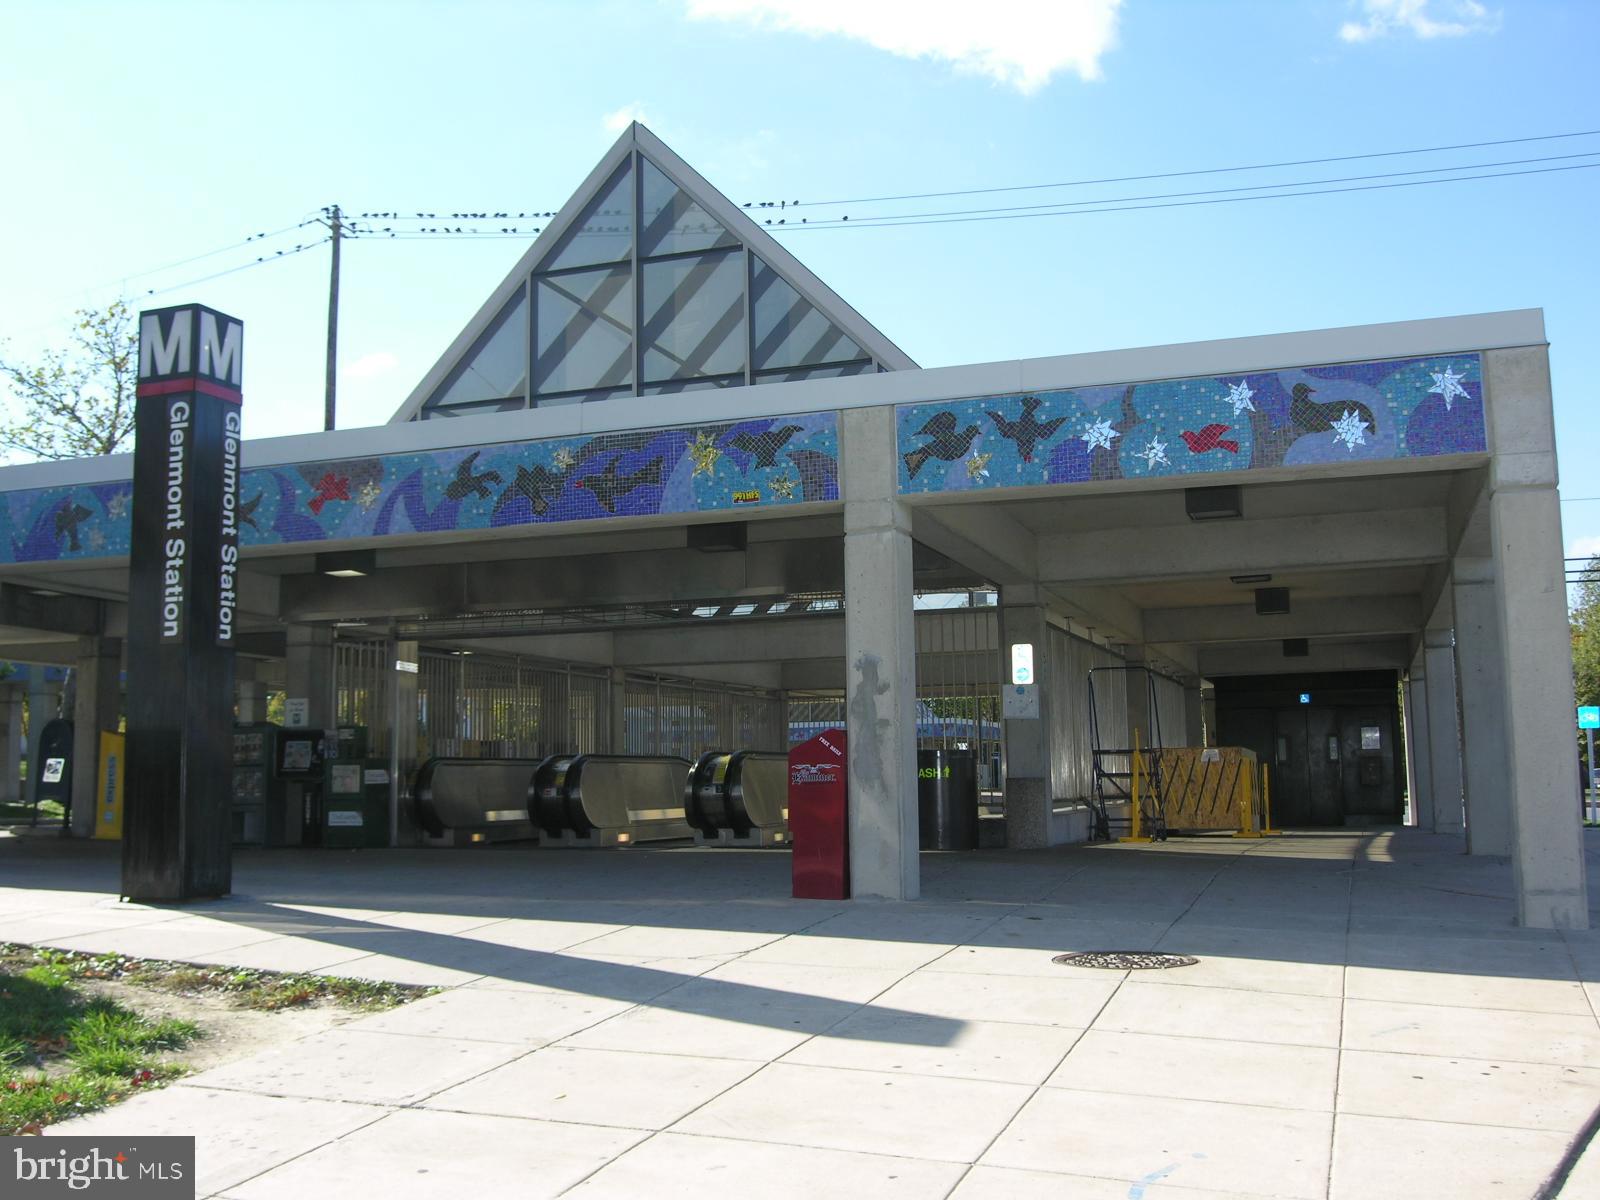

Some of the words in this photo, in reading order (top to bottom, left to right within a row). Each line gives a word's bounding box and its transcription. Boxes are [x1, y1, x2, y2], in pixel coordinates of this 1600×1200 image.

[140, 309, 192, 378] M
[198, 310, 241, 386] M
[167, 401, 190, 530] Glenmont
[223, 411, 240, 536] Glenmont
[164, 538, 186, 637] Station
[219, 544, 238, 640] Station
